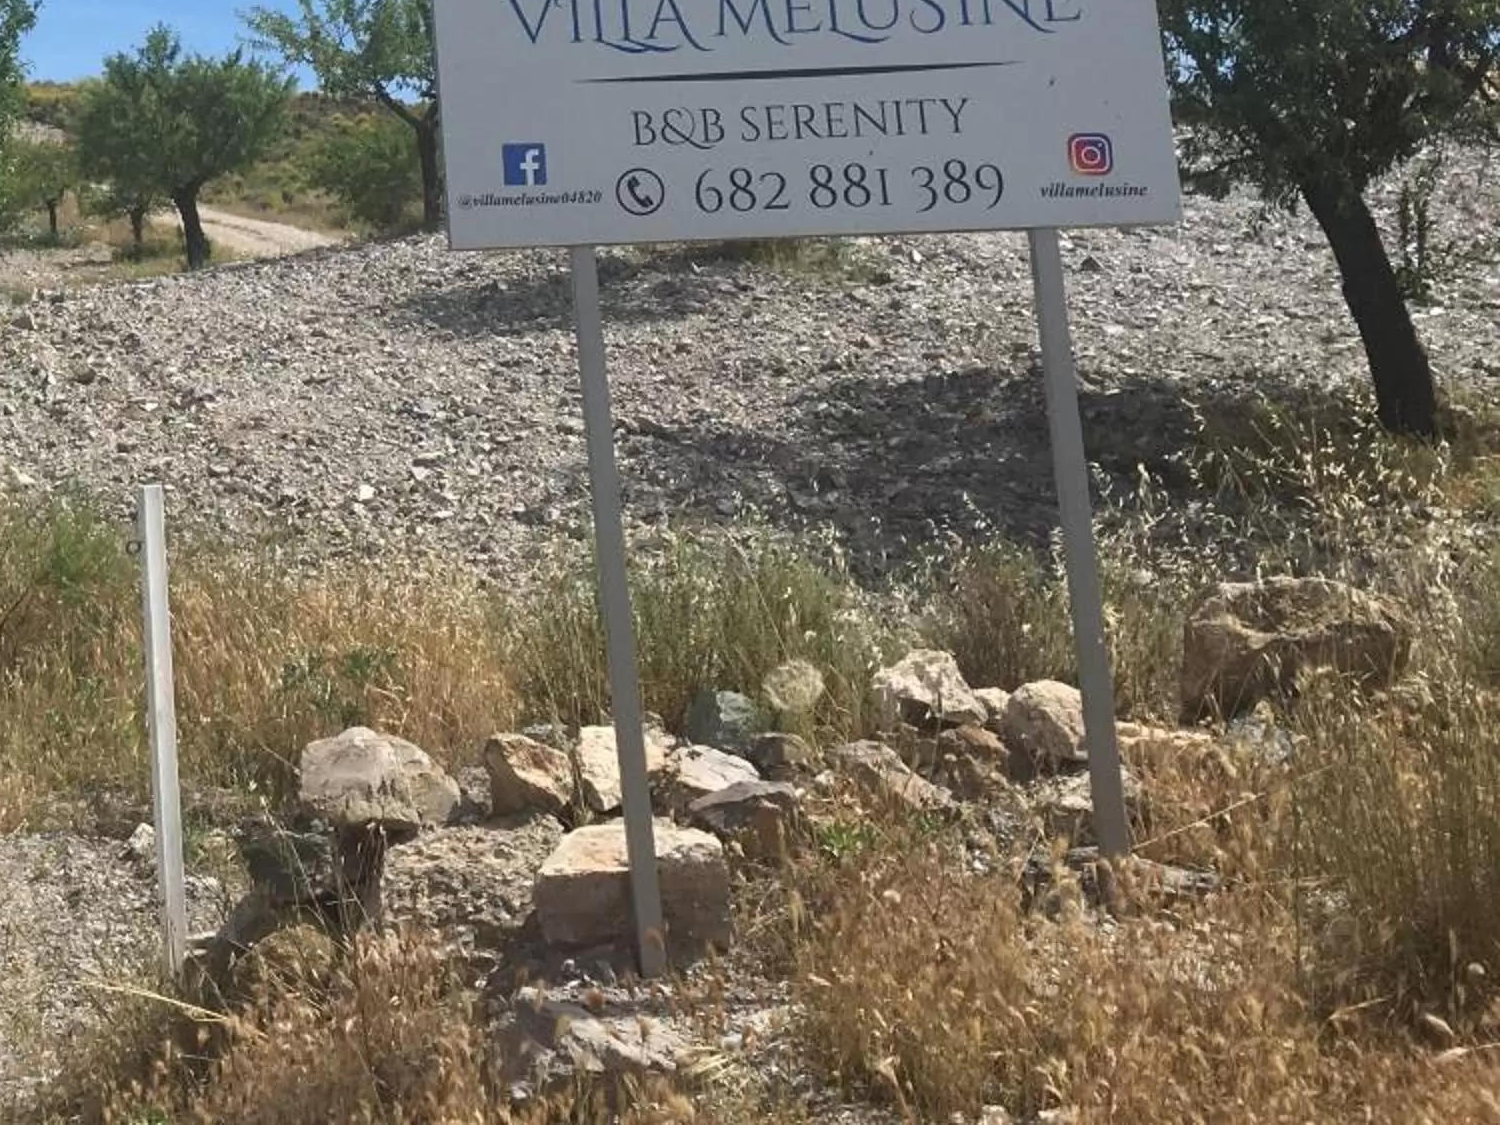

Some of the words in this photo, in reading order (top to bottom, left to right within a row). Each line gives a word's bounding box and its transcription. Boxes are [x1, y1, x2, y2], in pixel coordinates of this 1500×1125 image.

[631, 107, 726, 150] B&B
[740, 97, 970, 142] SERENITY
[695, 166, 792, 213] 682
[809, 162, 894, 209] 881
[911, 158, 1005, 213] 389
[1040, 181, 1150, 198] villamelusine
